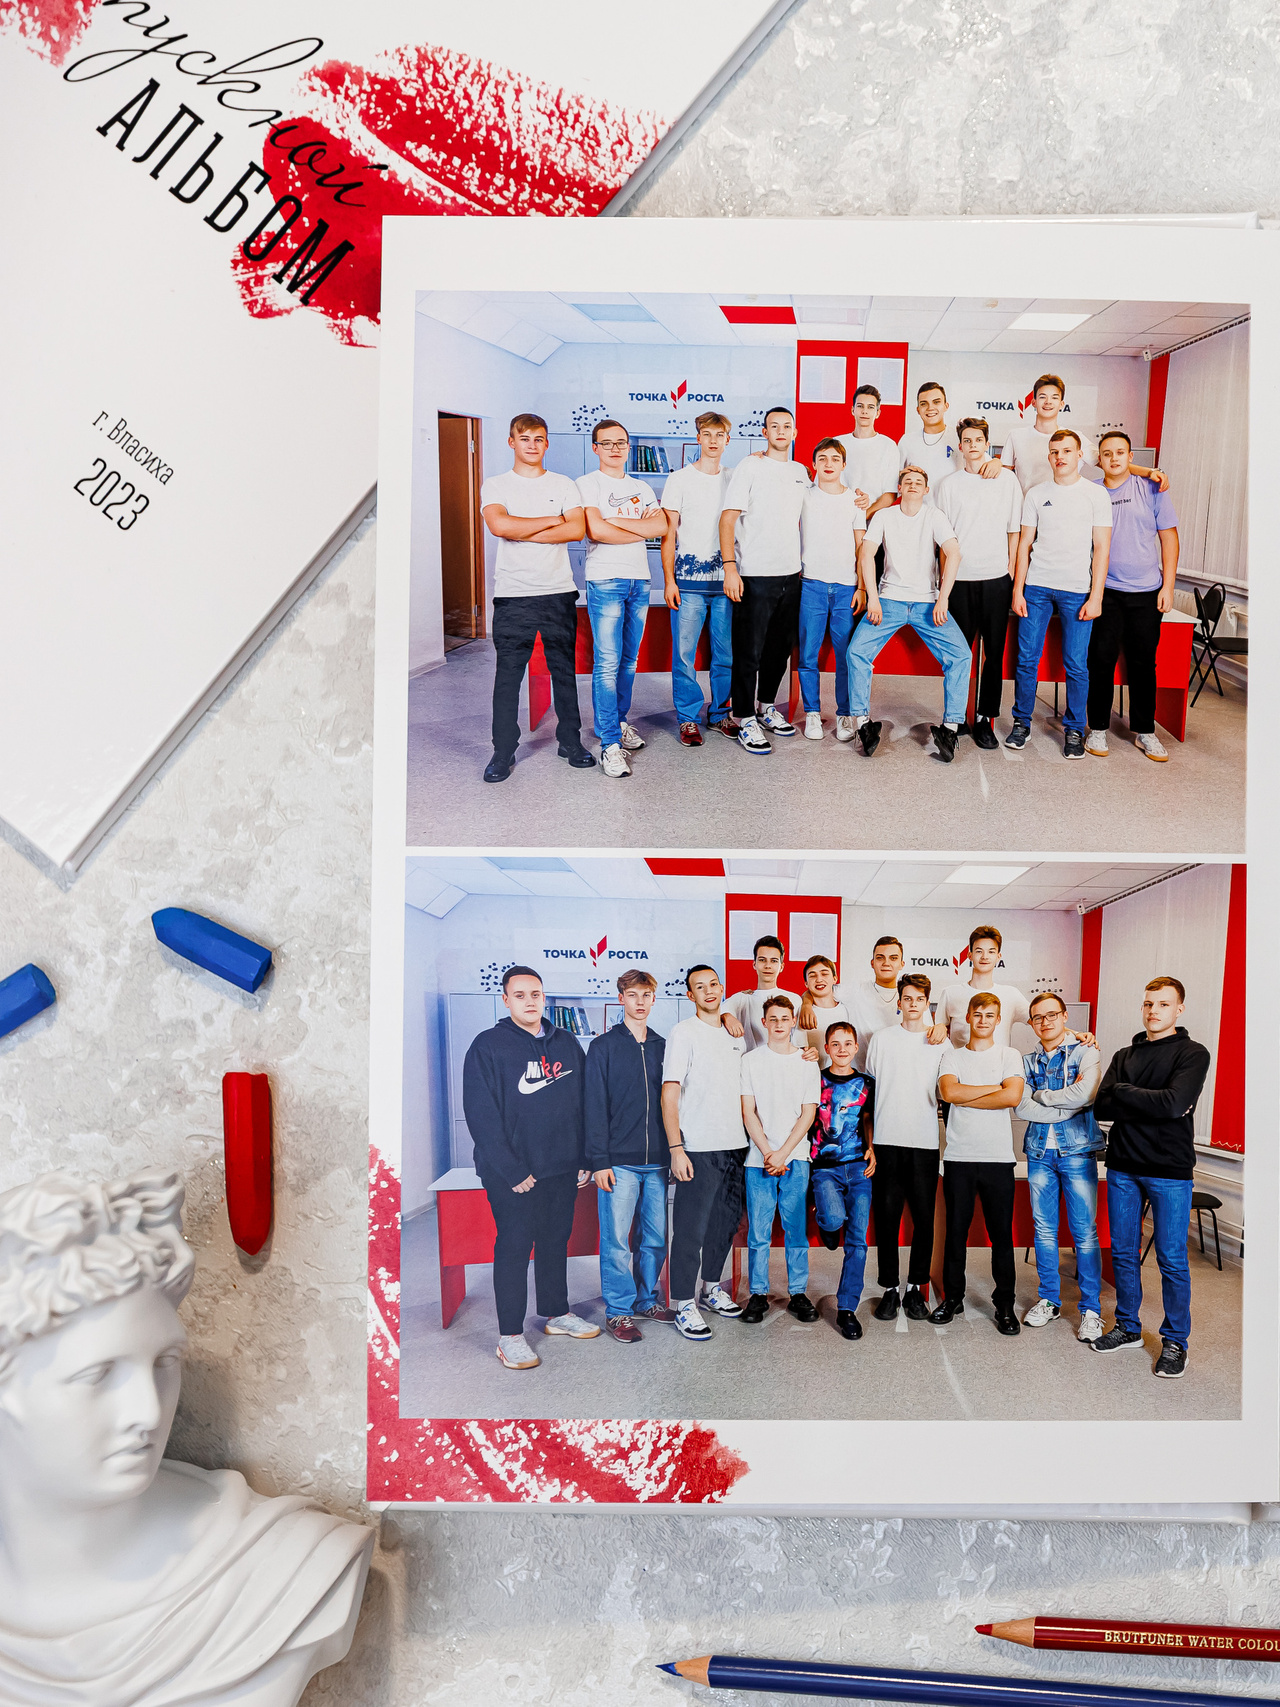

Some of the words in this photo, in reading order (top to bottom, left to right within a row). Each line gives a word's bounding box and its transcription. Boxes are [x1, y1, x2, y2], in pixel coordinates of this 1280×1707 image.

[96, 77, 355, 306] АЛЬБОМ
[628, 392, 668, 402] ТОЧКА
[687, 393, 725, 402] РОСТА
[976, 401, 1015, 411] ТОЧКА
[92, 410, 108, 431] г.
[107, 417, 174, 485] Власиха
[73, 457, 150, 531] 2023
[617, 507, 640, 516] AIR
[542, 949, 587, 959] ТОЧКА
[608, 950, 649, 960] РОСТА
[911, 957, 950, 967] ТОЧКА
[1103, 1631, 1184, 1647] BRUTFUNER
[1188, 1635, 1234, 1649] WATER
